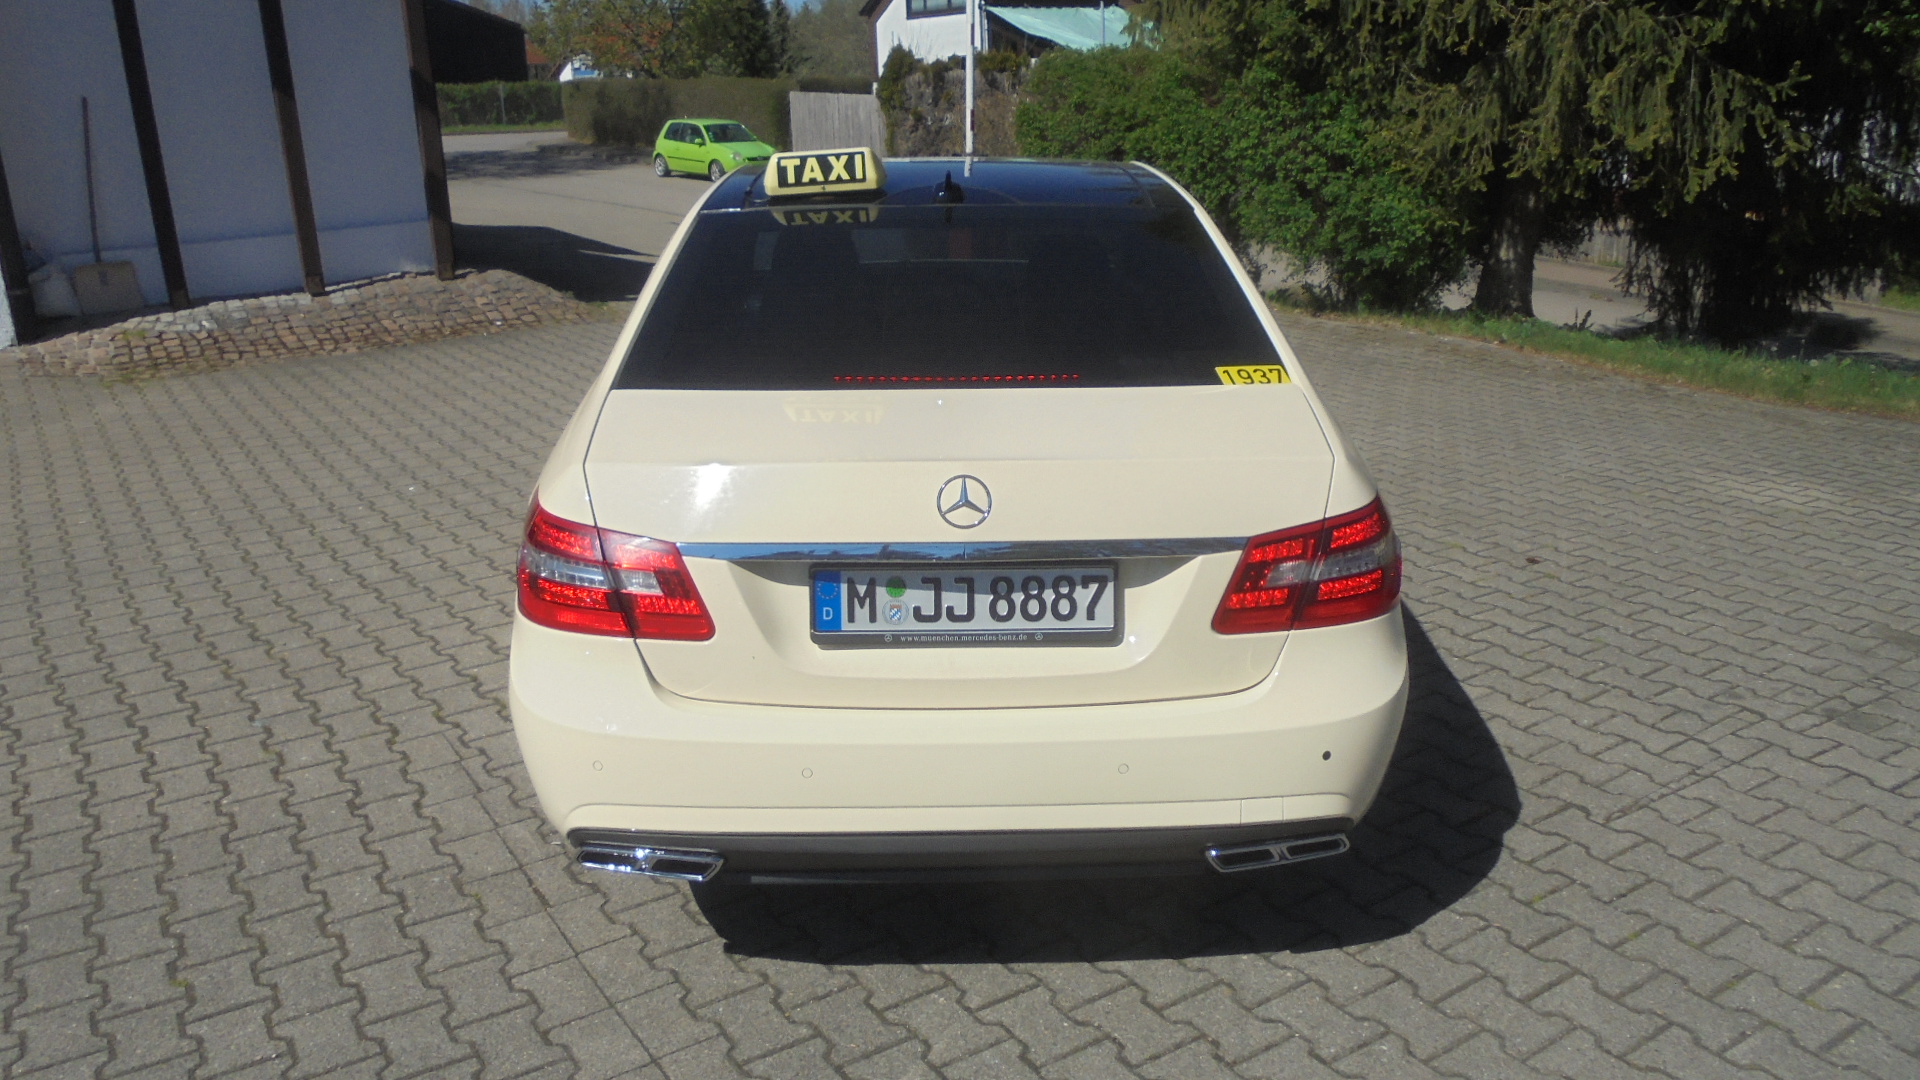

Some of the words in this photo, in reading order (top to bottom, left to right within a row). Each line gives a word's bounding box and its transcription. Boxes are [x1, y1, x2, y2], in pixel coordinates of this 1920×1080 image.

[780, 153, 864, 185] TAXI
[1222, 368, 1282, 385] 1937
[847, 577, 877, 623] M
[912, 577, 975, 623] JJ
[988, 575, 1109, 622] 8887
[822, 607, 833, 620] D
[900, 633, 1028, 642] www.muenchen.mercedes-benz.de
